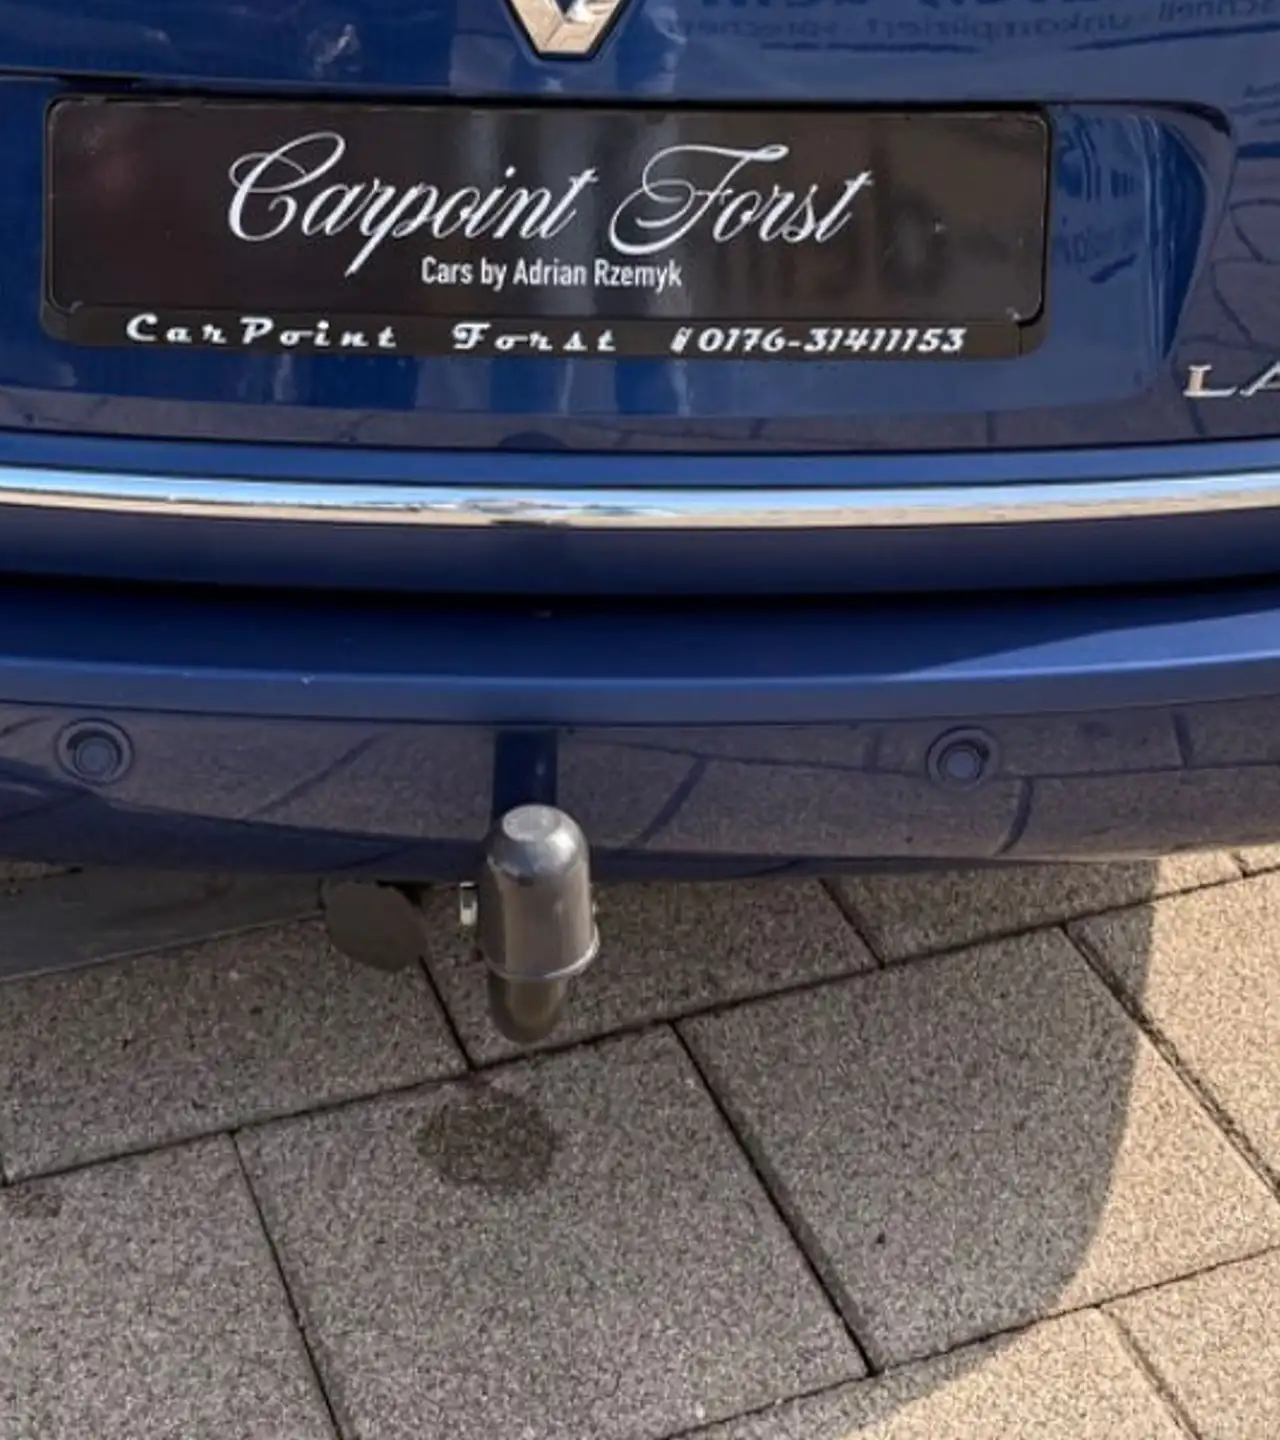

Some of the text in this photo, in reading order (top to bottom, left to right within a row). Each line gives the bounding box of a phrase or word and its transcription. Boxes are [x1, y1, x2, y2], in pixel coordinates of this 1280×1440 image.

[228, 131, 874, 277] Carpoint Forst
[421, 255, 682, 294] Cars by Adrian Rzemyk
[125, 313, 967, 353] CarPoint Forst 0176-31411153
